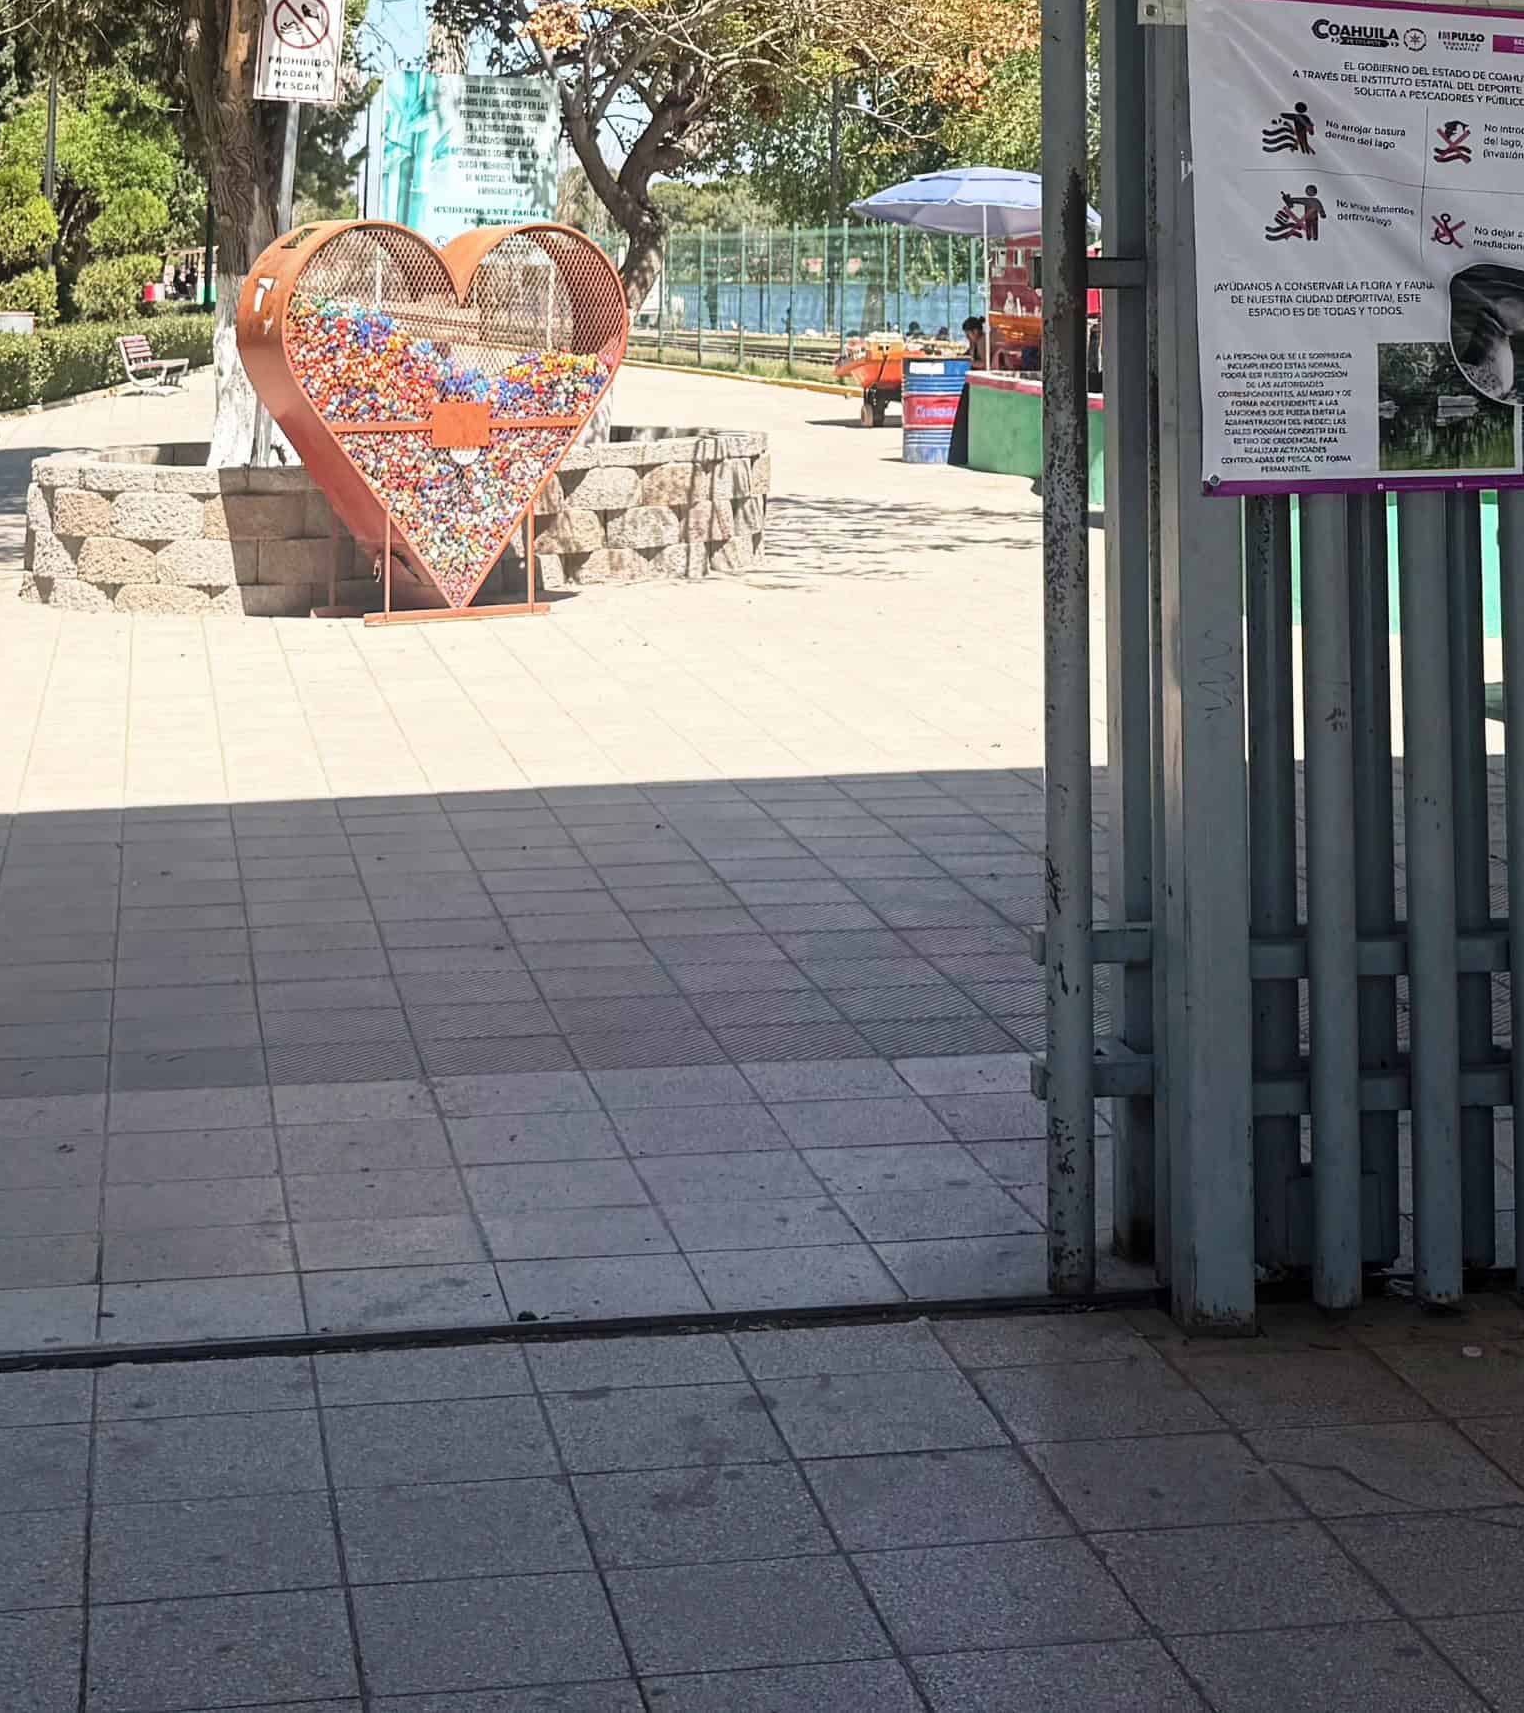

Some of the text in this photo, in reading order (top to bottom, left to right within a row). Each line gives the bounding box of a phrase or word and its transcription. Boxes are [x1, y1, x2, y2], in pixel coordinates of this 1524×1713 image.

[1311, 19, 1399, 40] COAHUILA
[1438, 30, 1485, 42] IMPULSO
[274, 69, 311, 79] NADAR
[1344, 62, 1355, 70] EL
[1358, 63, 1409, 74] GOBIERNO
[1412, 66, 1429, 75] DEL
[1432, 67, 1470, 79] ESTADO
[1473, 71, 1485, 79] DE
[1293, 70, 1300, 78] A
[1302, 70, 1338, 82] TRAVÉS
[1341, 73, 1358, 82] DEL
[1361, 75, 1412, 86] INSTITUTO
[1415, 78, 1454, 90] ESTATAL
[1457, 81, 1475, 91] DEL
[1478, 83, 1522, 94] DEPORTE
[1354, 86, 1397, 98] SOLICITA
[1400, 90, 1407, 98] A
[1409, 90, 1474, 103] PESCADORES
[1477, 95, 1483, 103] Y
[1326, 119, 1405, 136] No arrojar basura
[1484, 124, 1498, 133] No
[1325, 131, 1395, 149] dentro del lago
[1483, 136, 1498, 146] del
[1500, 137, 1523, 149] lago,
[1474, 226, 1488, 236] No
[1491, 227, 1514, 238] dejar
[1274, 282, 1282, 291] A
[1284, 281, 1343, 291] CONSERVAR
[1346, 281, 1358, 291] LA
[1361, 281, 1392, 290] FLORA
[1395, 281, 1401, 290] Y
[1405, 281, 1435, 290] FAUNA
[1231, 294, 1244, 304] DE
[1247, 294, 1293, 304] NUESTRA
[1295, 294, 1333, 304] CIUDAD
[1397, 293, 1421, 302] ESTE
[1248, 307, 1290, 317] ESPACIO
[1293, 307, 1305, 317] ES
[1307, 307, 1321, 316] DE
[1324, 307, 1355, 316] TODAS
[1357, 306, 1365, 316] Y
